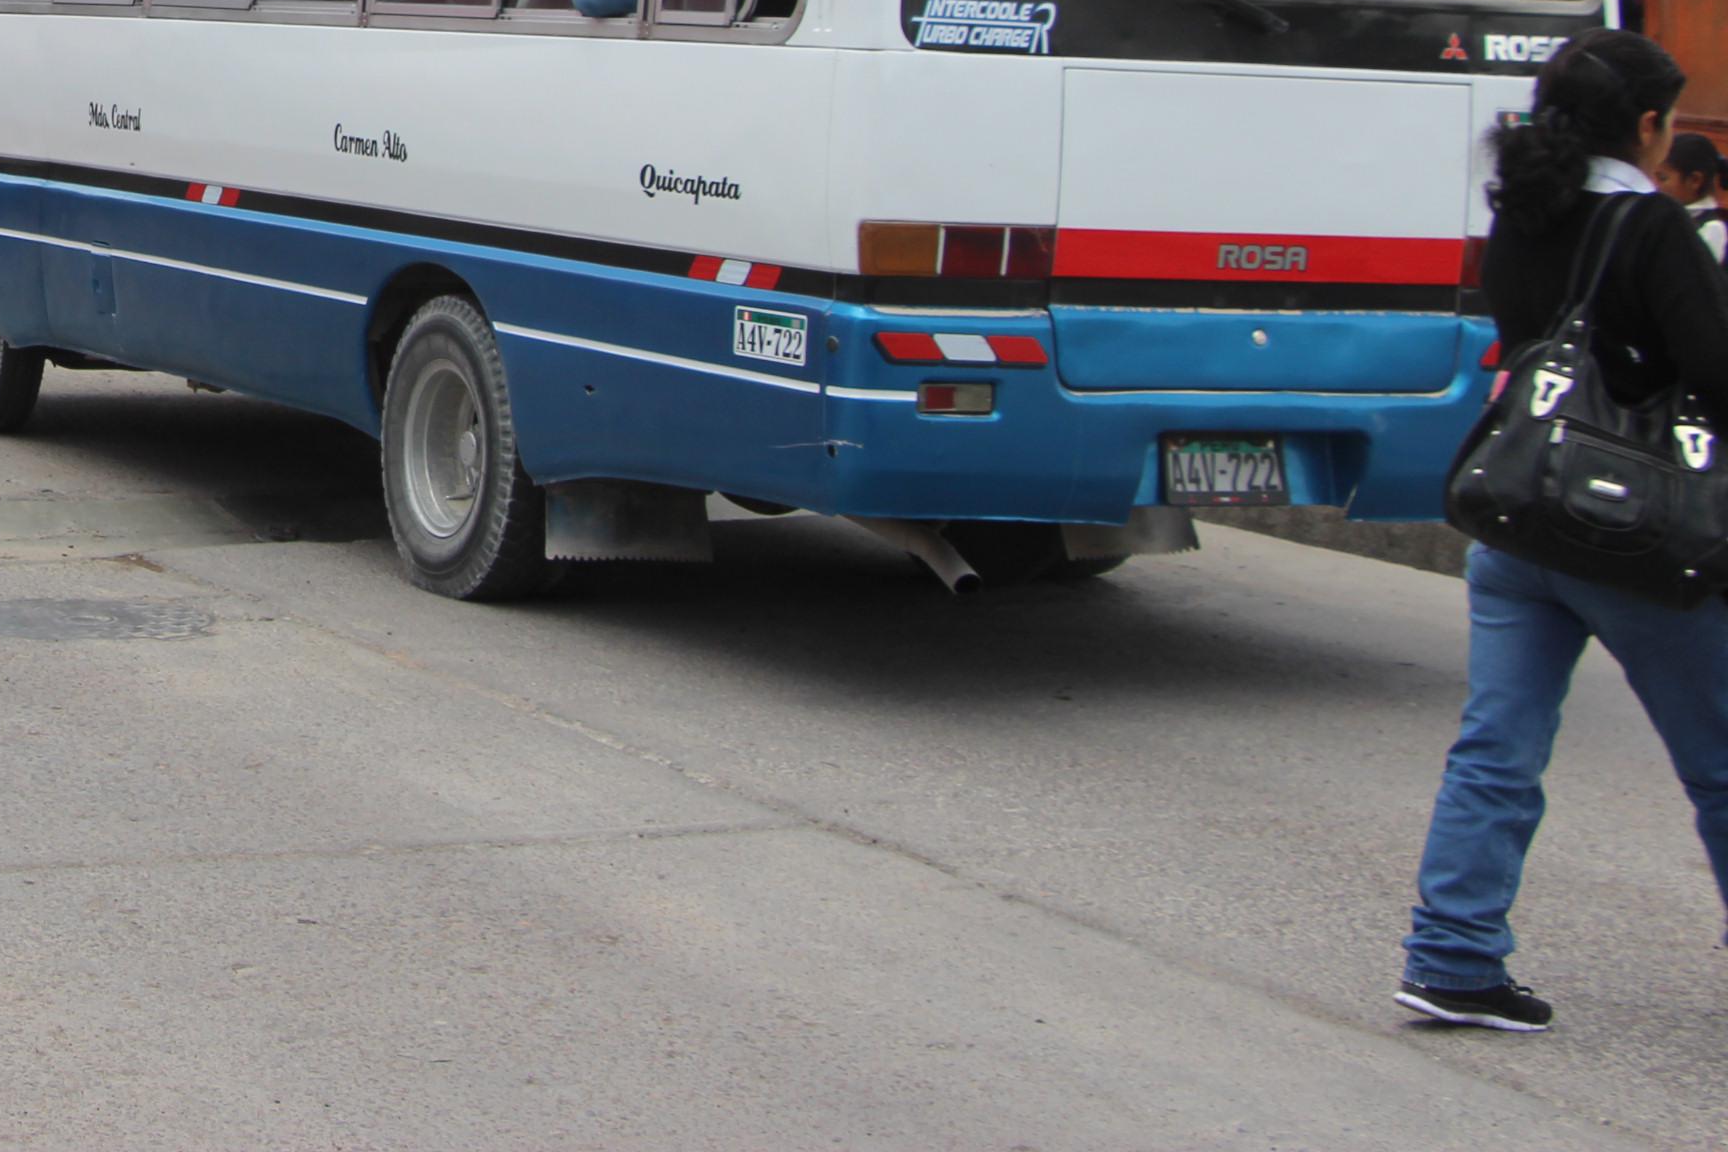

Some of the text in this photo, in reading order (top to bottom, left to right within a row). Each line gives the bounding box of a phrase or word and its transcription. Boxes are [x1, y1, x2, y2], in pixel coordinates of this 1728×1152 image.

[1484, 34, 1570, 62] ROS
[111, 103, 142, 132] Central
[334, 123, 408, 163] Carmen Alto
[640, 164, 742, 206] Quicapata
[1217, 244, 1308, 271] ROSA
[736, 321, 803, 360] A4V-722
[1170, 451, 1278, 492] A4V-722
